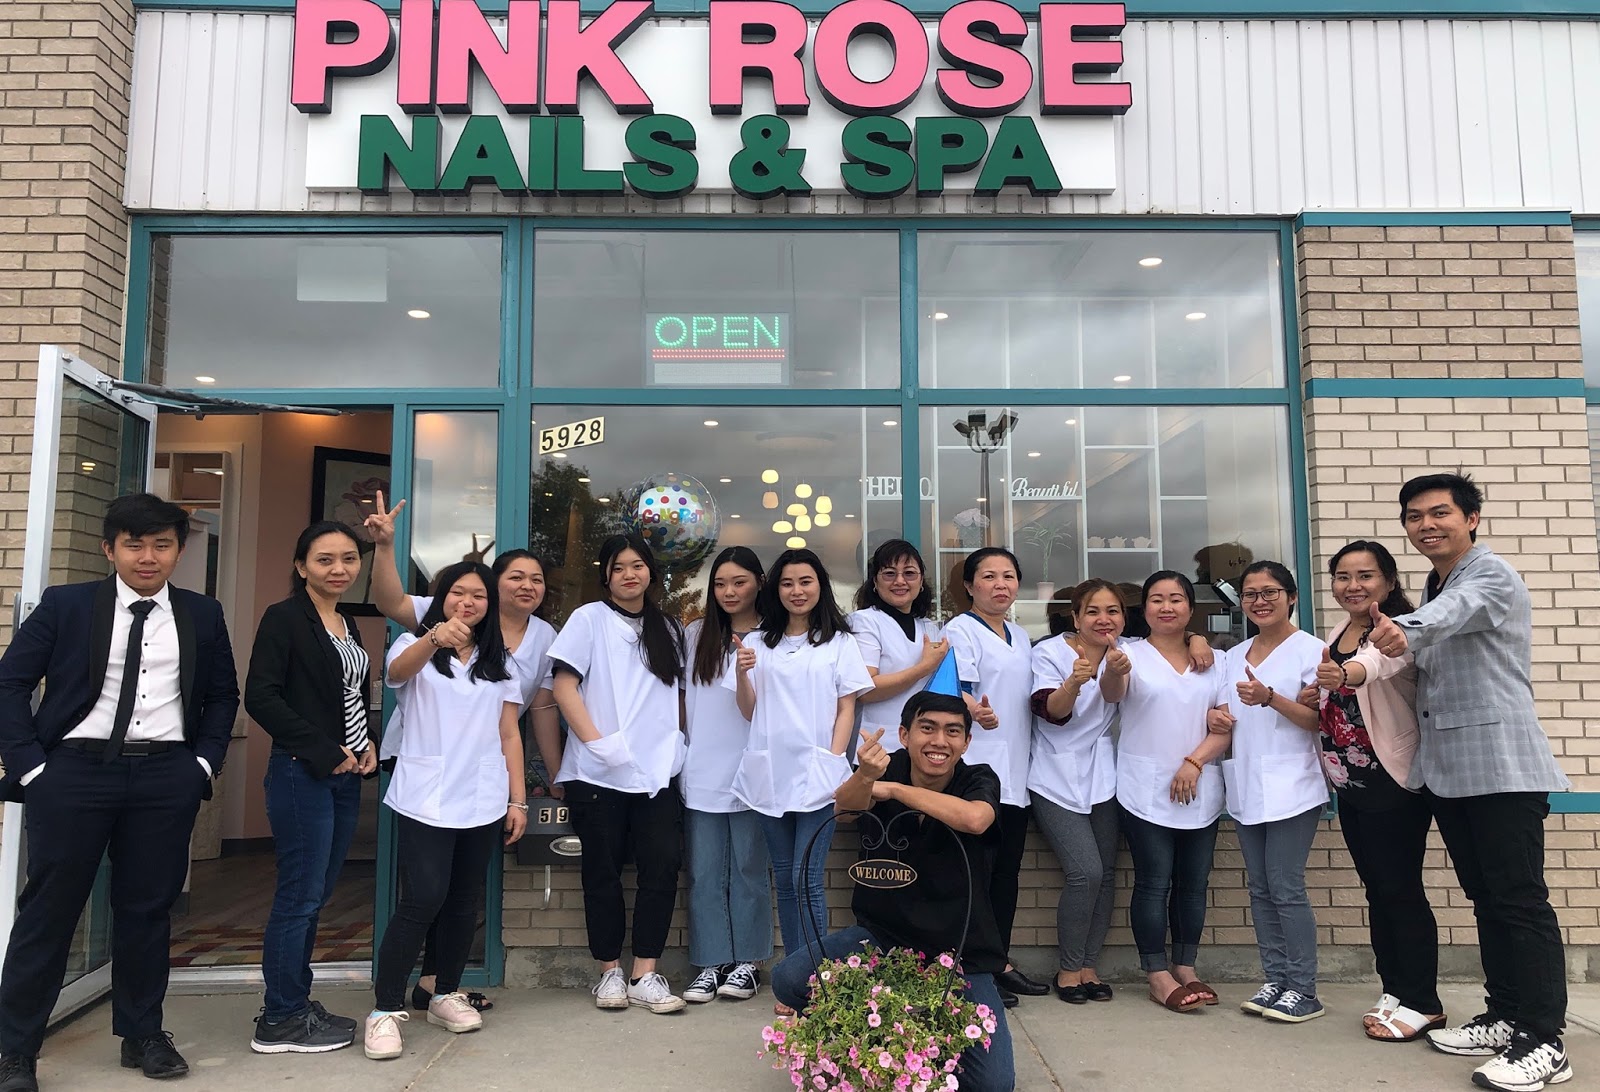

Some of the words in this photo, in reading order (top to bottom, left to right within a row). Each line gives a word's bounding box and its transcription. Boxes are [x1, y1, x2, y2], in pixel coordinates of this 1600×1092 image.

[292, 0, 655, 114] PINK
[709, 0, 1132, 117] ROSE
[358, 114, 699, 199] NAILS
[729, 110, 812, 199] &
[841, 115, 1063, 198] SPA
[655, 316, 779, 348] OPEN
[541, 419, 601, 452] 5928
[855, 866, 911, 881] WELCOME
